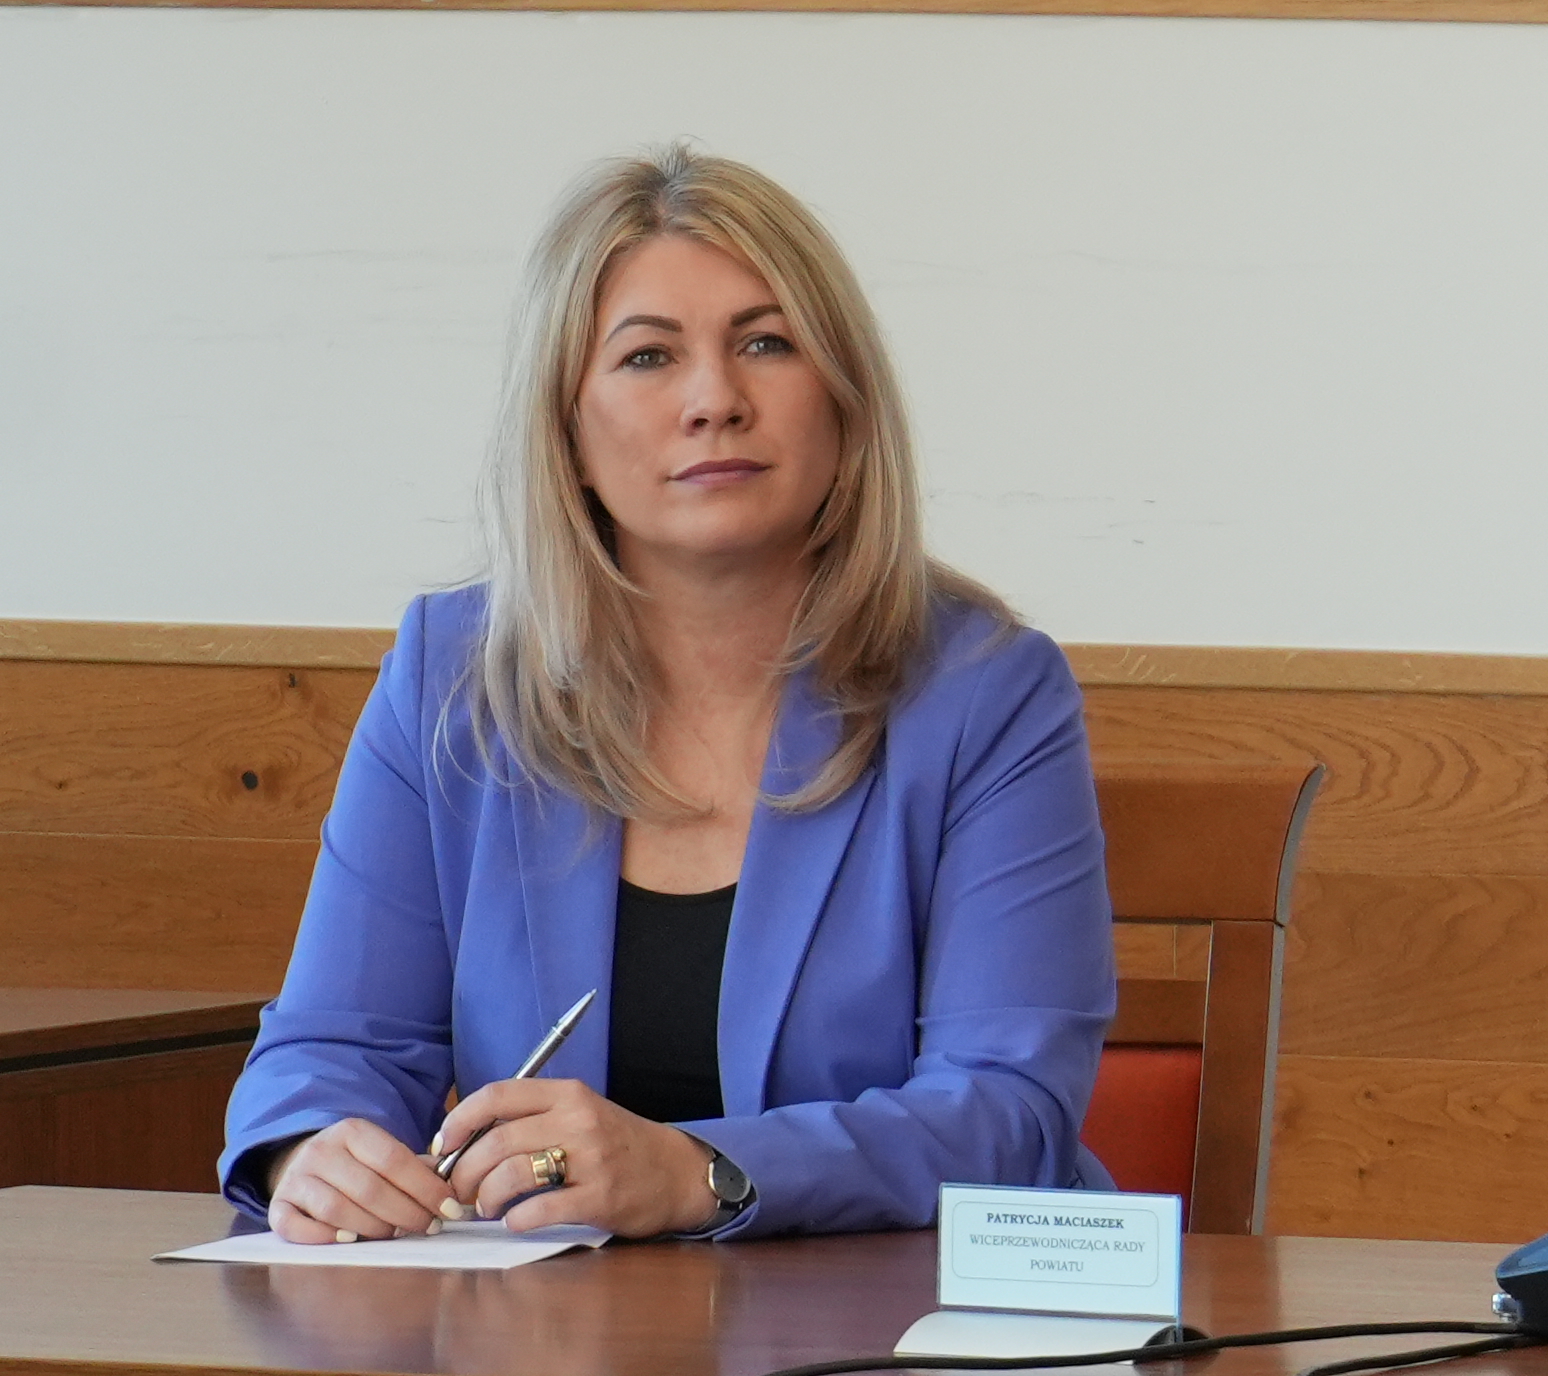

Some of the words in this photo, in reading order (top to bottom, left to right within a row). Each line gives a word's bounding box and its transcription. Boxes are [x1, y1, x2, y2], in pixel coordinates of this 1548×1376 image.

[986, 1212, 1050, 1226] PATRYCJA
[1053, 1215, 1125, 1229] MACIASZEK
[969, 1234, 1110, 1252] WICEPRZEWODNICZĄCA
[1113, 1240, 1146, 1253] RADY
[1030, 1259, 1084, 1272] POWIATU
